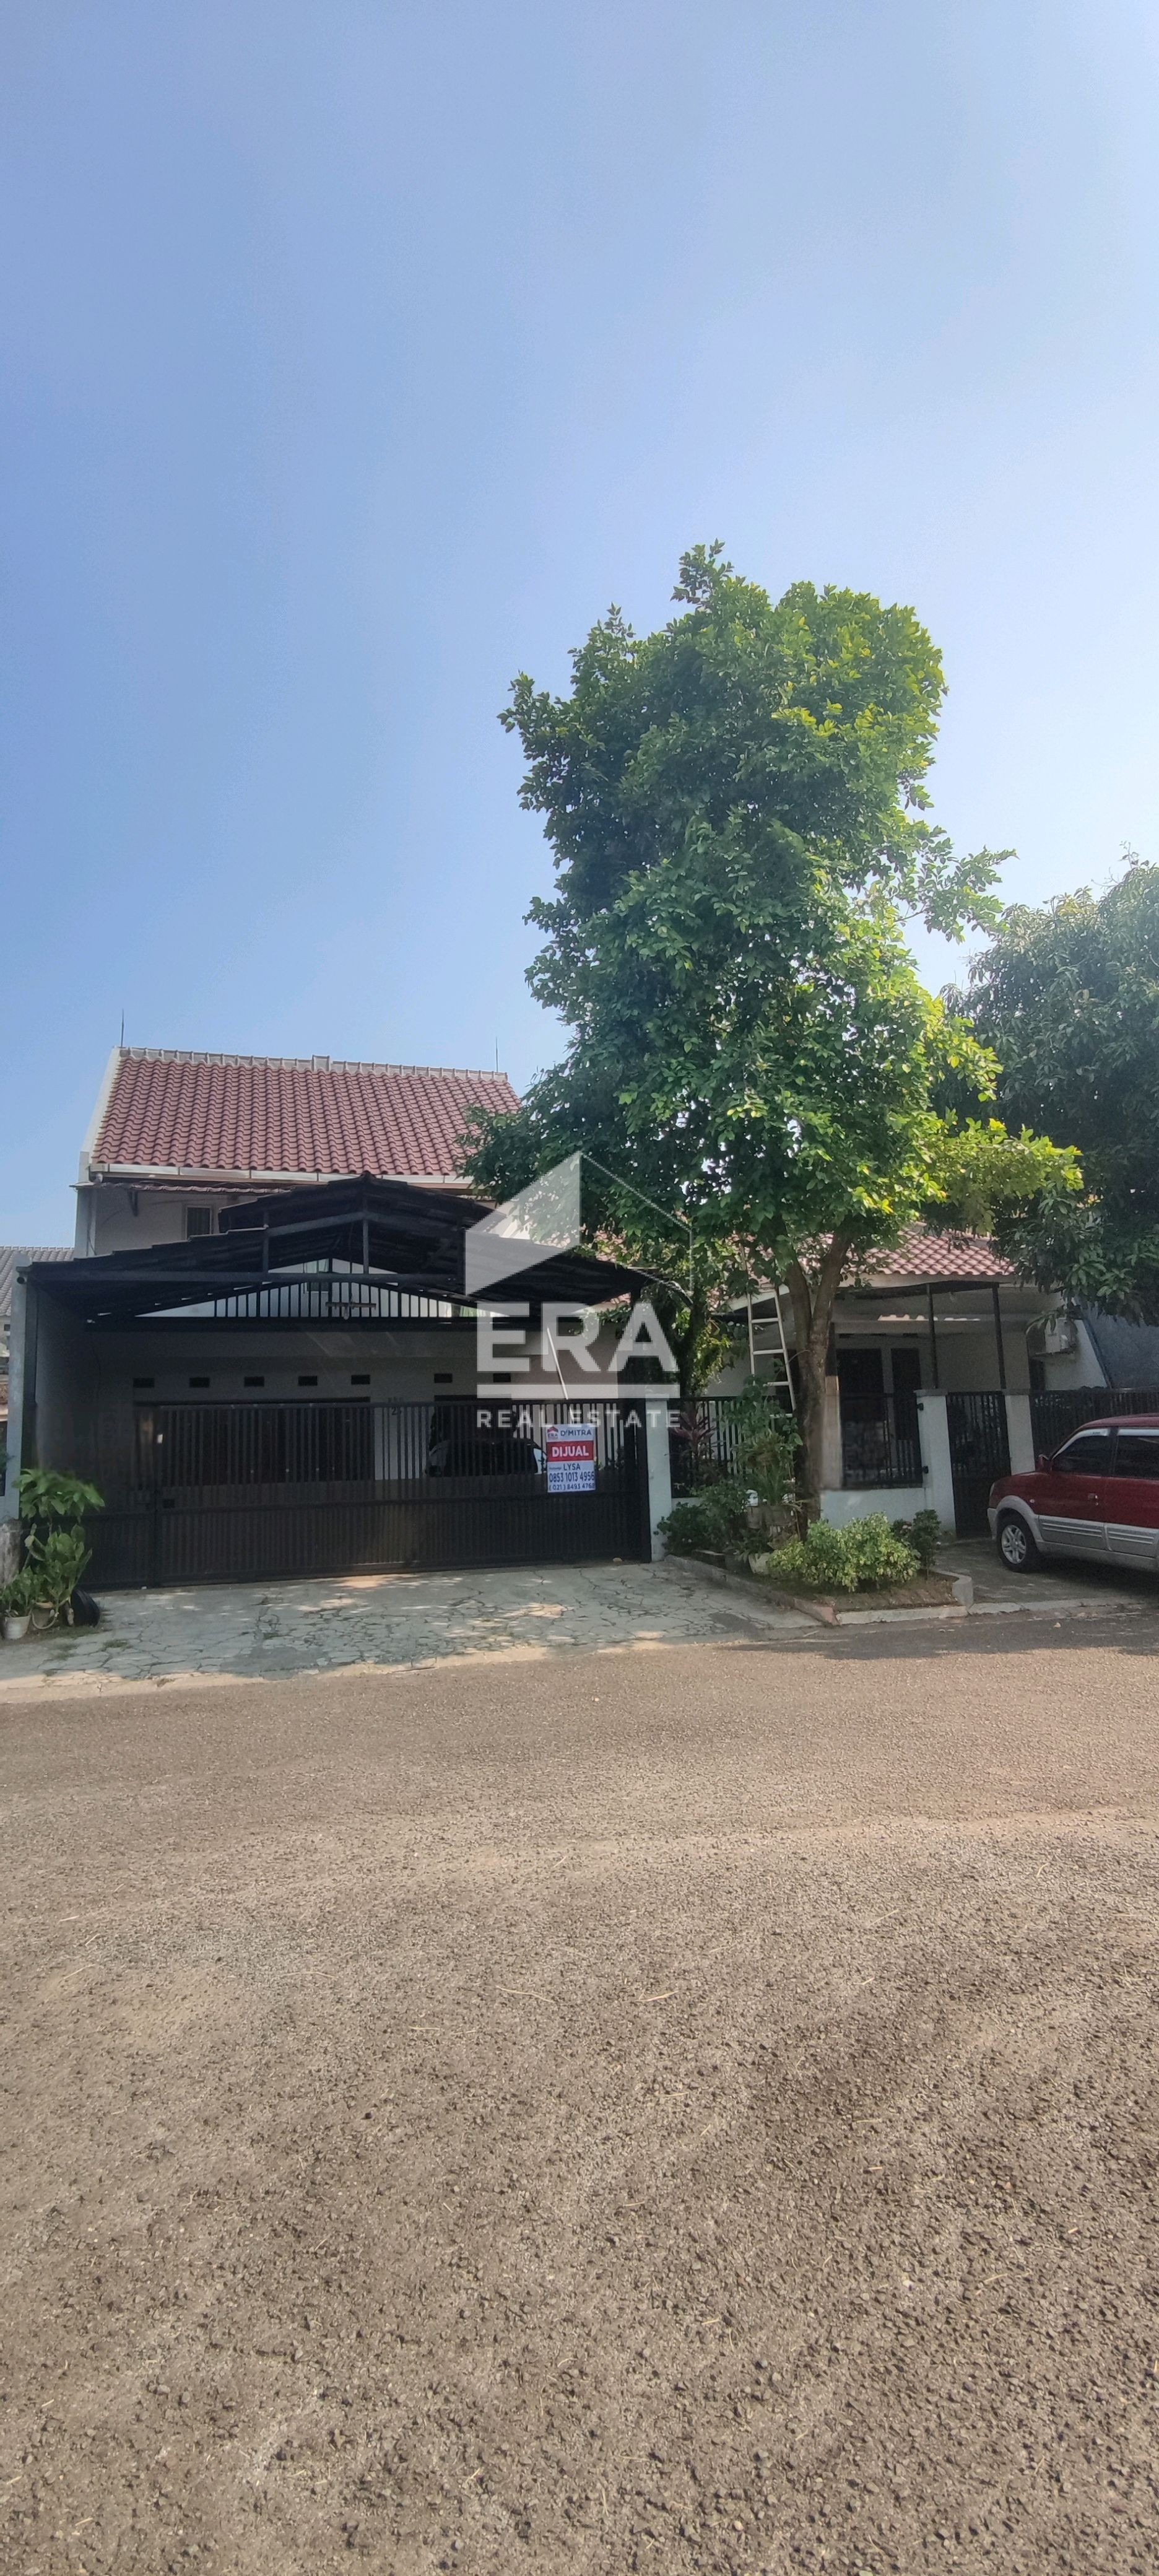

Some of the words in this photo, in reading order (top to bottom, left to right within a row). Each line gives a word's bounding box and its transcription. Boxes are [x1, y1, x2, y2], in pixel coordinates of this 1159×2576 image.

[552, 1446, 589, 1457] DIJUAL
[549, 1473, 563, 1482] 0853
[565, 1472, 578, 1482] 1013
[580, 1471, 594, 1481] 4956
